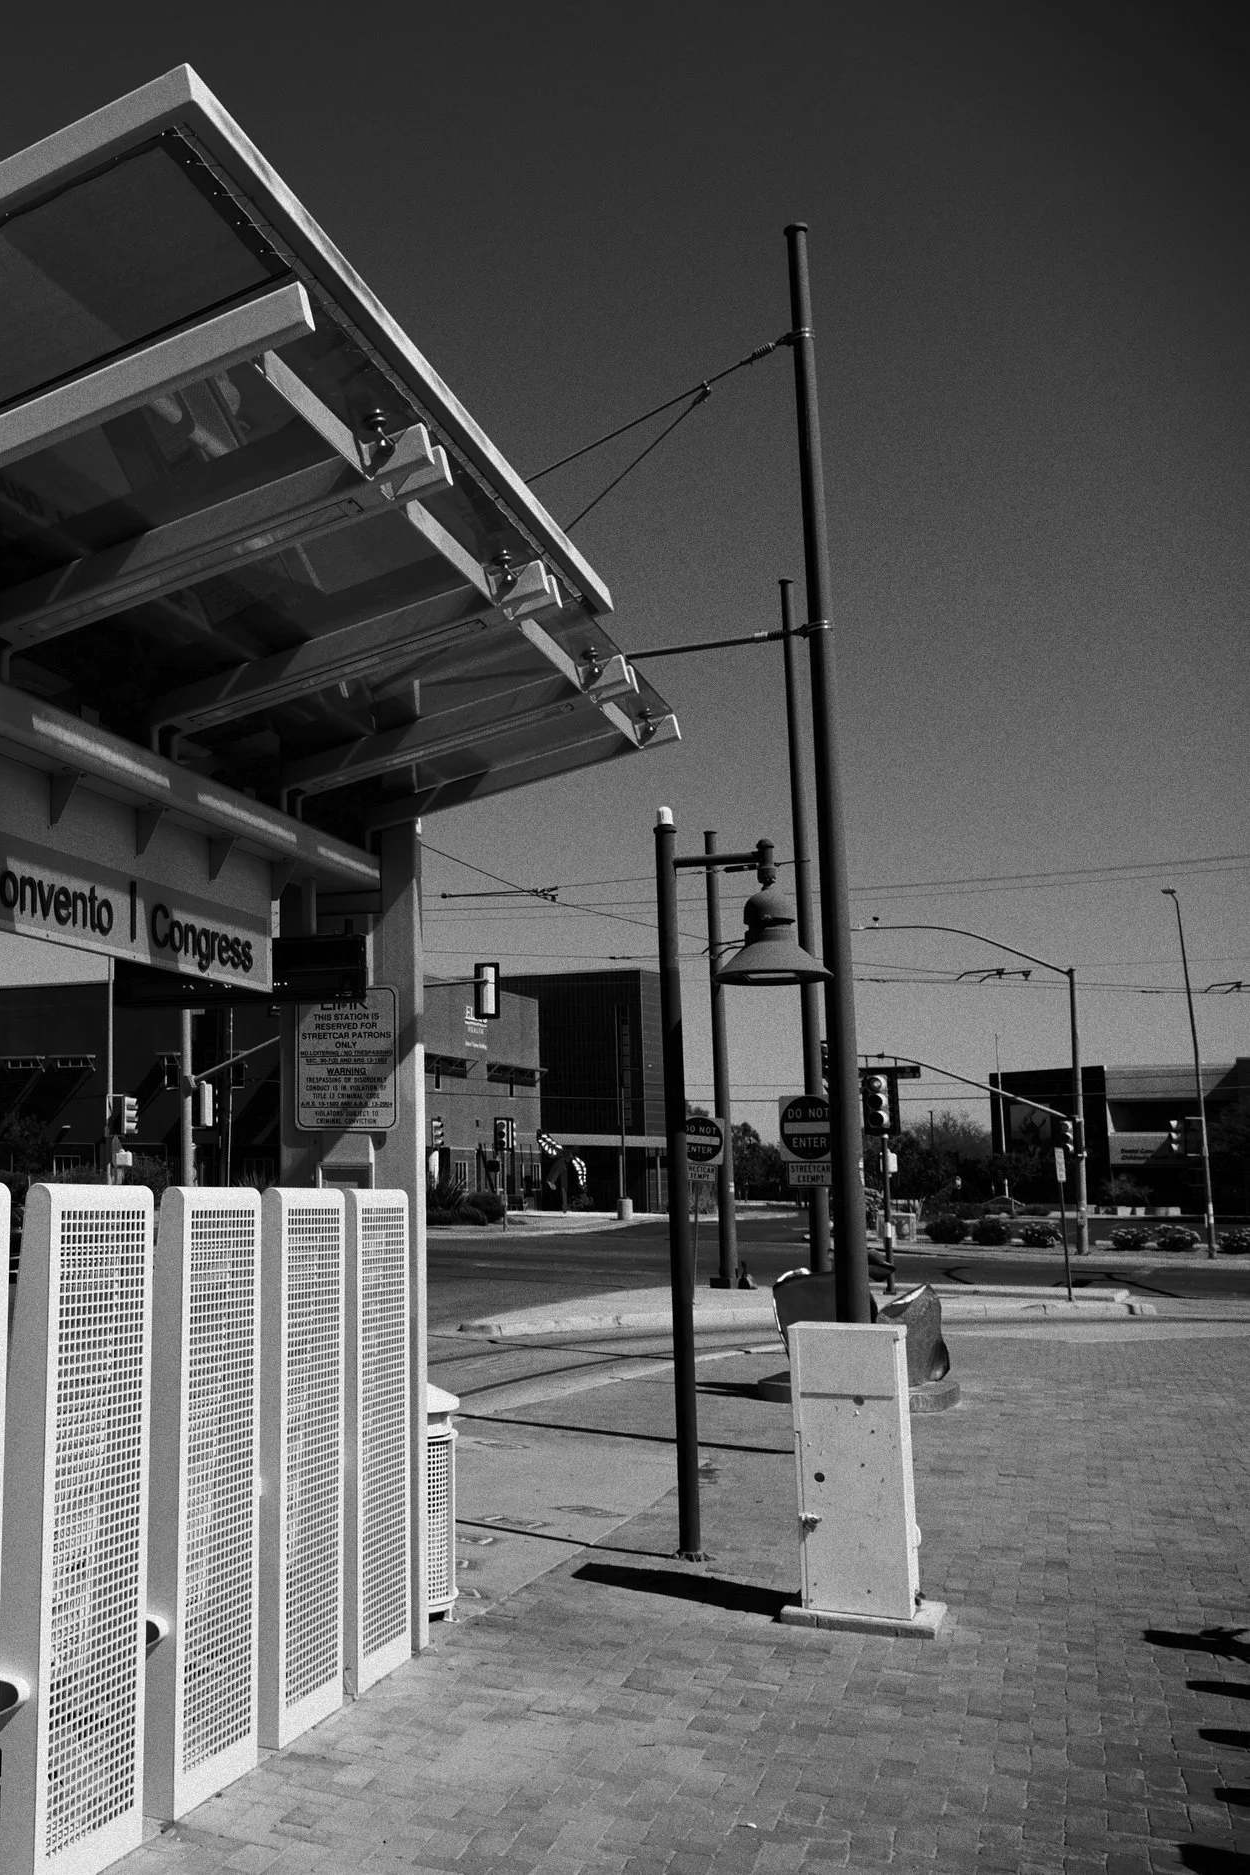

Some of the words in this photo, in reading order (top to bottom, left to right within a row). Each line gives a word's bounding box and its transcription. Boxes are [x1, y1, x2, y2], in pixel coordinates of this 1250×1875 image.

[151, 903, 253, 972] Congress
[326, 1068, 367, 1076] WARNING
[788, 1108, 802, 1118] DO
[809, 1108, 829, 1118] NOT
[699, 1126, 716, 1134] NOT
[792, 1138, 827, 1148] ENTER
[687, 1145, 712, 1154] ENTER
[790, 1165, 830, 1173] STREETCAR
[797, 1174, 824, 1183] EXEMPT
